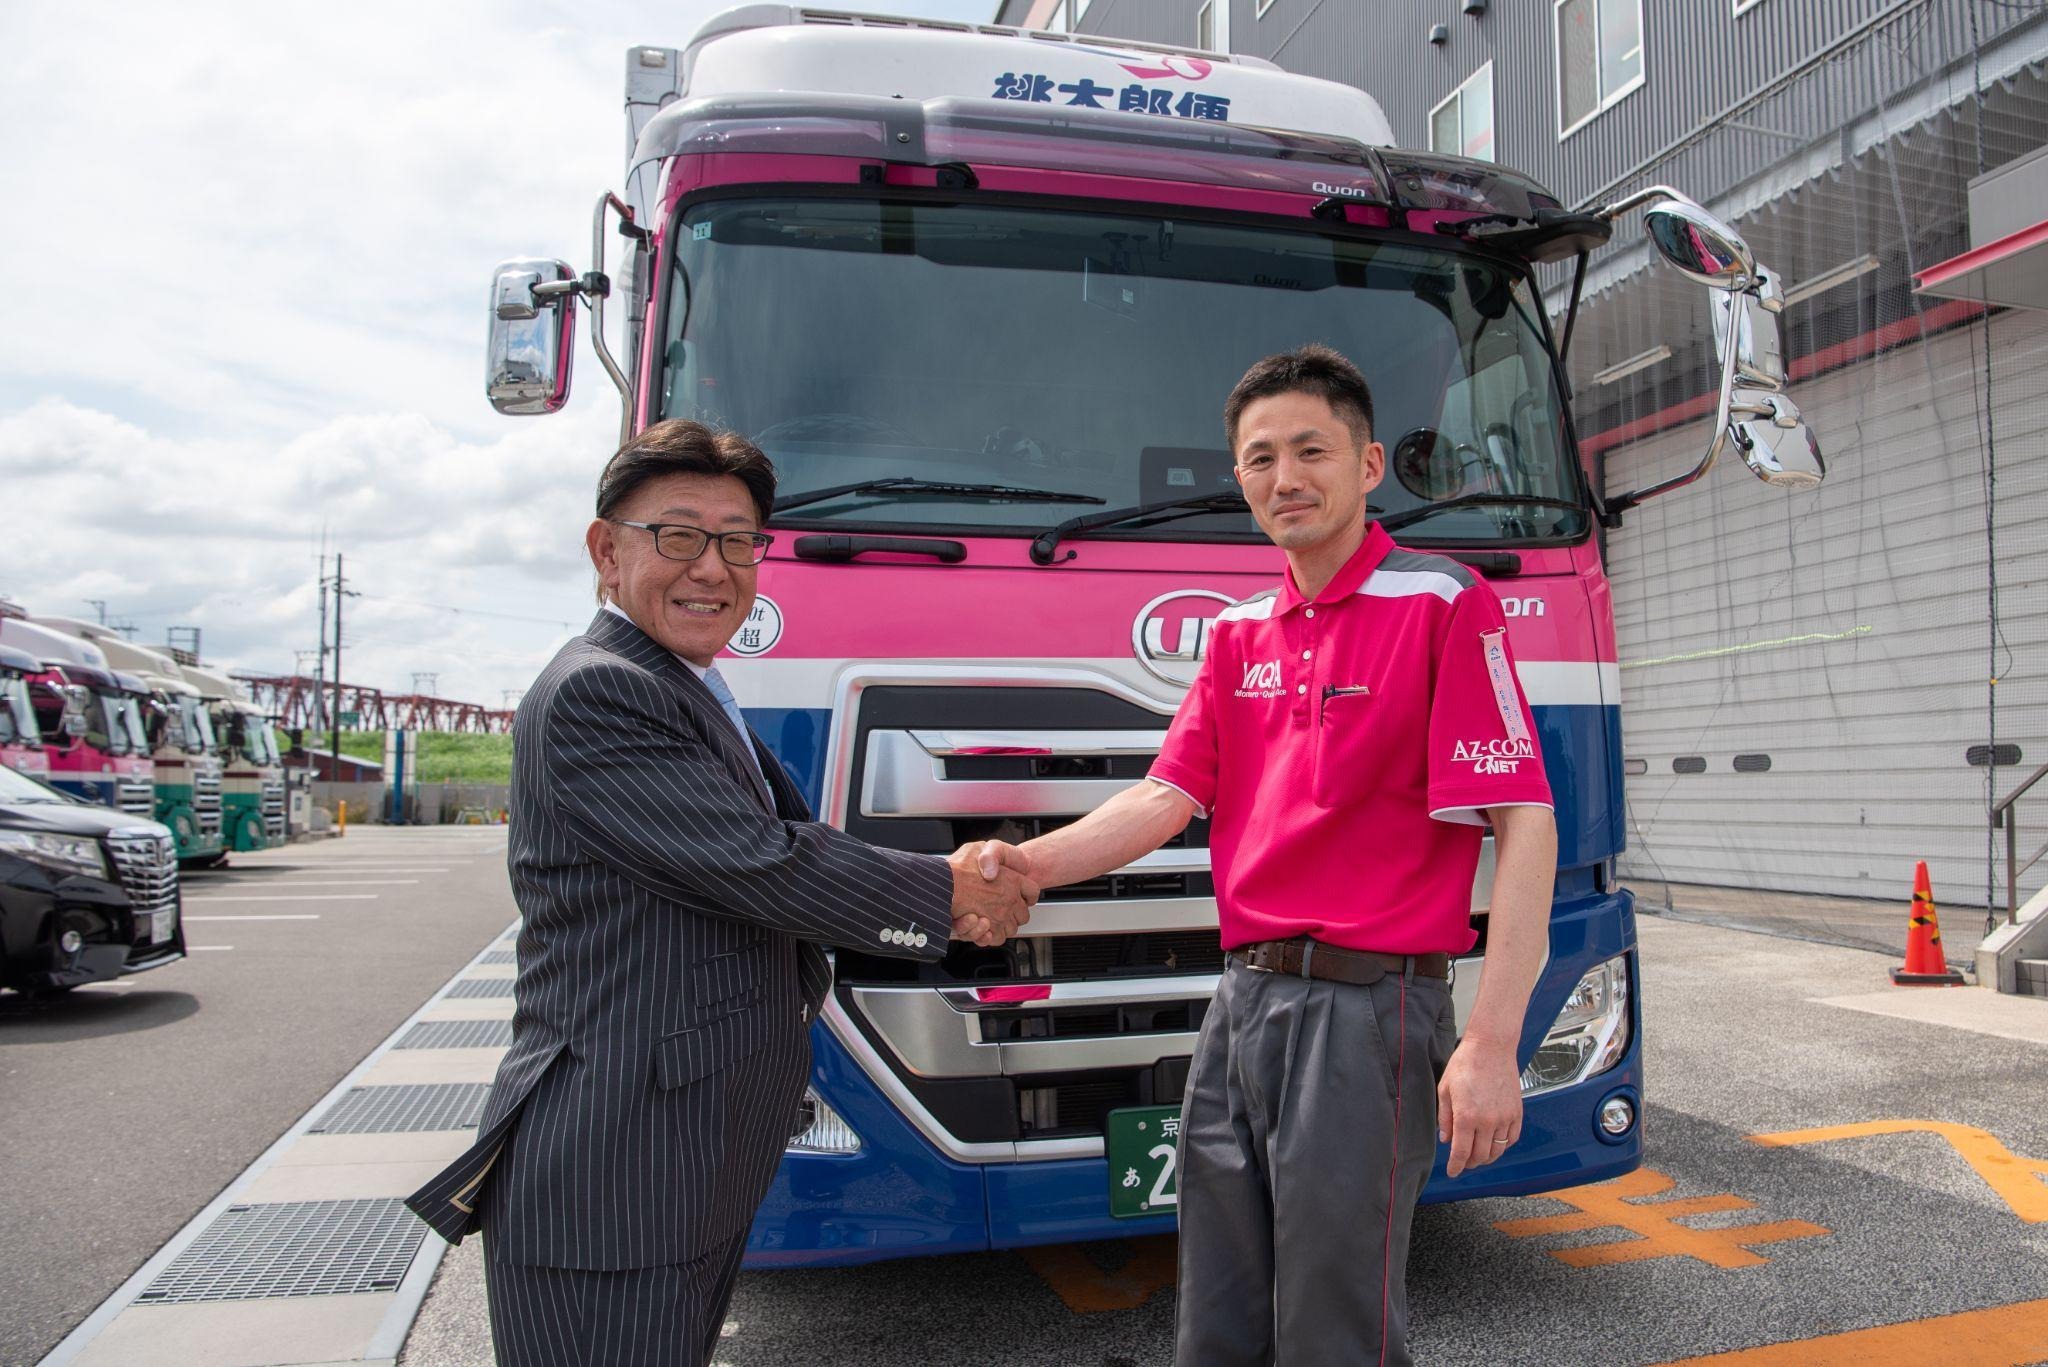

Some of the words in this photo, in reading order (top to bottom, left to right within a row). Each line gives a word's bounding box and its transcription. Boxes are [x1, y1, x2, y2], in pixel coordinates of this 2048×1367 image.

[992, 72, 1231, 121] 桃太郎便
[1312, 181, 1366, 198] Quon
[739, 627, 761, 647] 超
[1453, 739, 1534, 759] AZ-COM
[1122, 1166, 1141, 1188] あ
